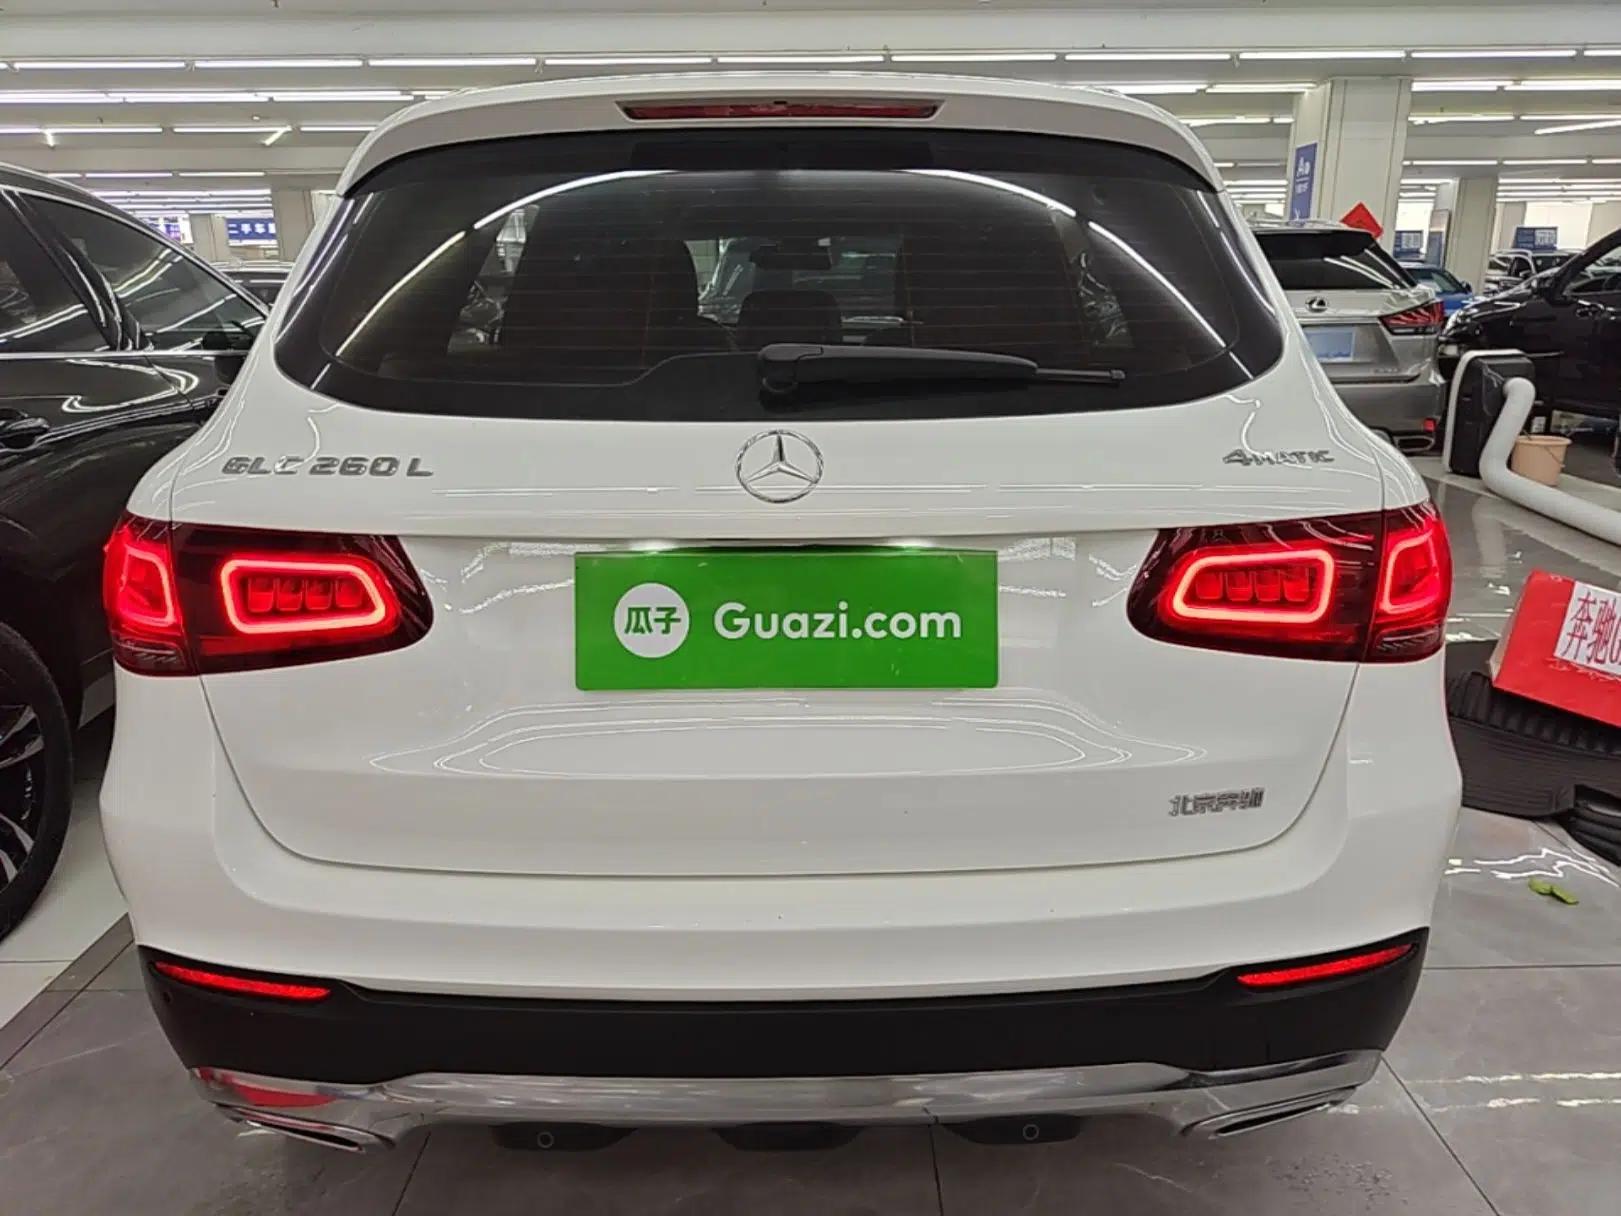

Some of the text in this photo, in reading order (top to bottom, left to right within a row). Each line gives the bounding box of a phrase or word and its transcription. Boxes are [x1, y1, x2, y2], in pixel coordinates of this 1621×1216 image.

[221, 456, 434, 477] GLC 260 L
[1222, 448, 1335, 467] 4MATIC
[624, 606, 682, 636] 瓜子
[713, 600, 963, 640] Guazi.com
[1168, 786, 1265, 817] 北京奔驰
